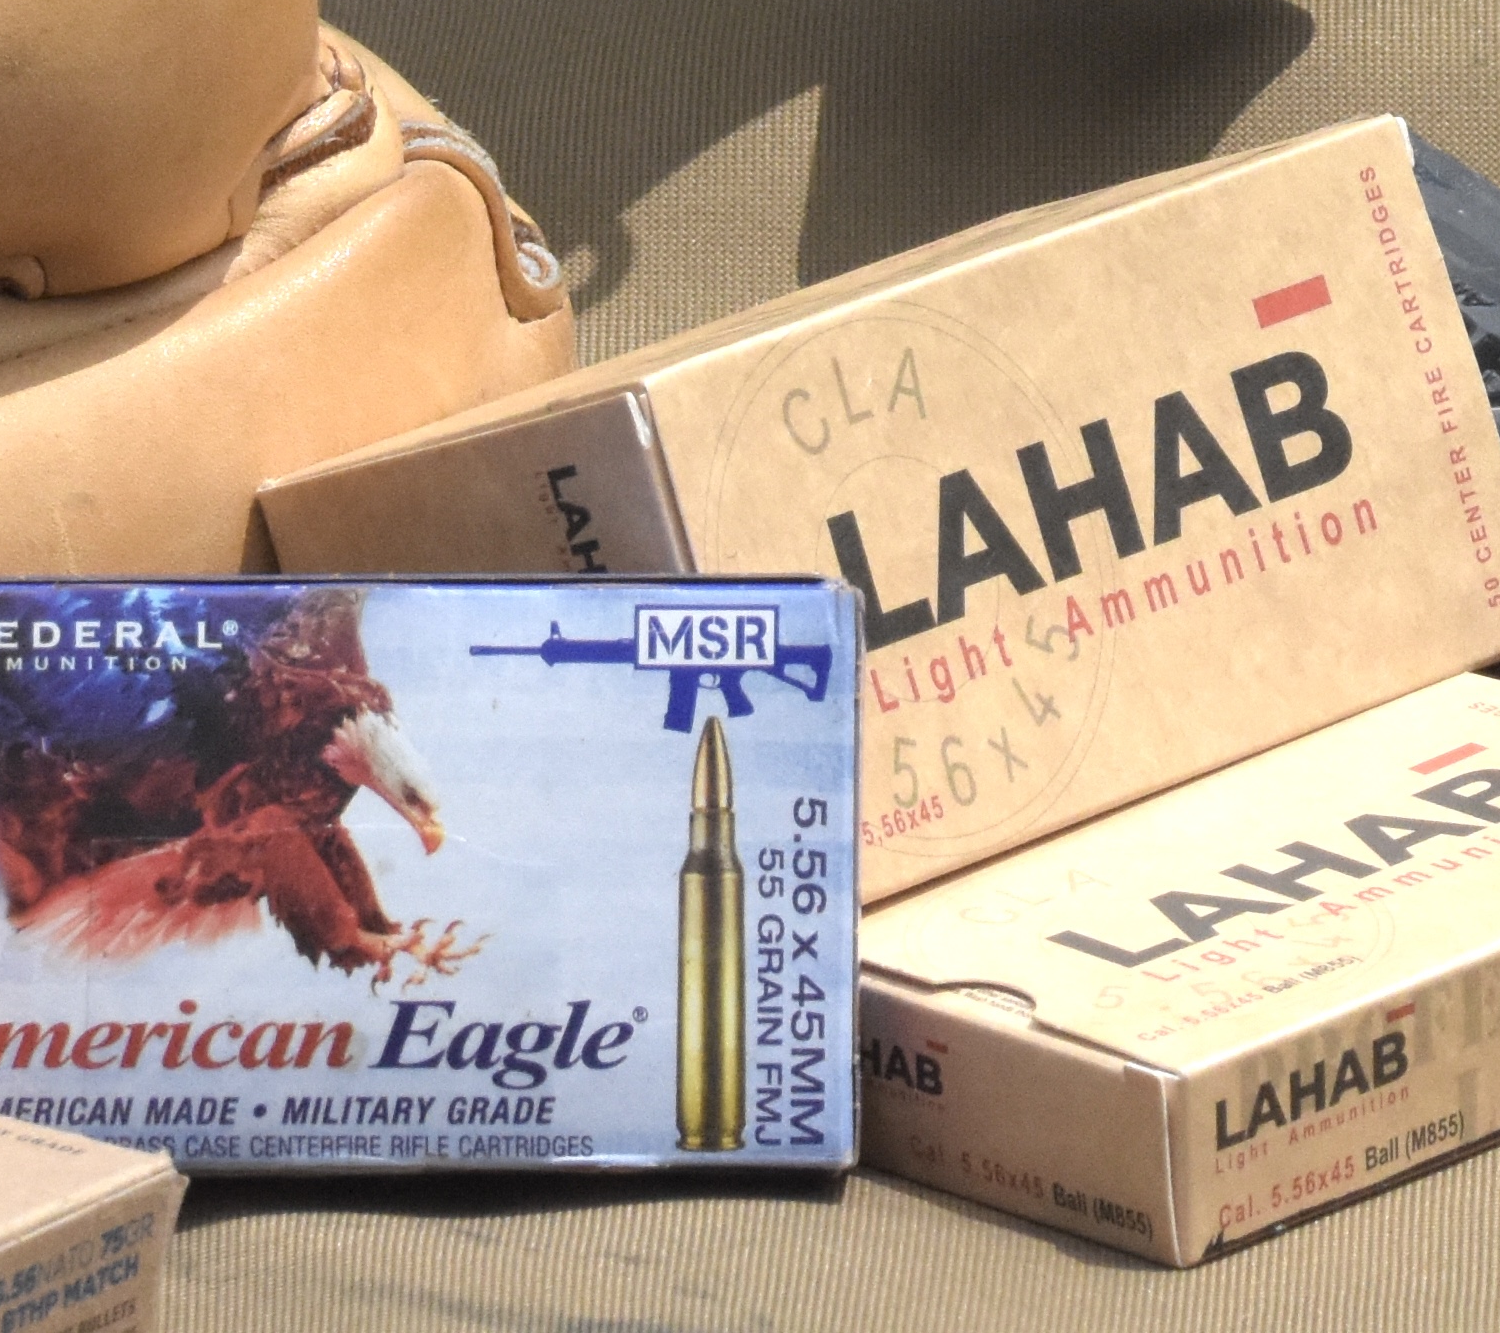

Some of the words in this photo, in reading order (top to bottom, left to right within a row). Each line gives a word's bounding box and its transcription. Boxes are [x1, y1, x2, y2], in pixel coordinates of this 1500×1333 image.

[1359, 165, 1435, 354] CARTRIDGES
[781, 346, 928, 457] CLA
[1424, 365, 1459, 435] FIRE
[546, 464, 609, 574] LAH
[826, 349, 1355, 653] LAHAB
[1448, 445, 1493, 564] CENTER
[647, 614, 769, 661] MSR
[869, 623, 1014, 714] Light
[1065, 496, 1381, 644] Ammunition
[757, 846, 786, 900] 55
[791, 795, 829, 916] 5.56
[756, 912, 786, 1048] GRAIN
[791, 929, 819, 962] x
[1140, 925, 1285, 983] Light
[1262, 976, 1297, 996] Ball
[1297, 953, 1362, 988] (M855)
[788, 973, 827, 1147] 45MM
[860, 1037, 944, 1097] HAB
[1215, 1030, 1410, 1152] LAHAB
[144, 1096, 241, 1126] MADE
[281, 1095, 437, 1126] MILITARY
[446, 1095, 558, 1126] GRADE
[184, 1135, 241, 1159] CASE
[250, 1135, 383, 1159] CENTERFIRE
[389, 1135, 450, 1159] RIFLE
[457, 1135, 595, 1159] CARTRIDGES
[753, 1061, 784, 1148] FMJ
[1214, 1140, 1270, 1175] Light
[1288, 1086, 1410, 1146] Ammunition
[1052, 1180, 1088, 1216] Ball
[1092, 1198, 1153, 1242] (M855)
[1217, 1194, 1262, 1231] Cal.
[1270, 1155, 1356, 1210] 5.56x45
[1364, 1136, 1400, 1172] Ball
[1404, 1110, 1466, 1161] (M855)
[62, 1251, 141, 1309] MATCH
